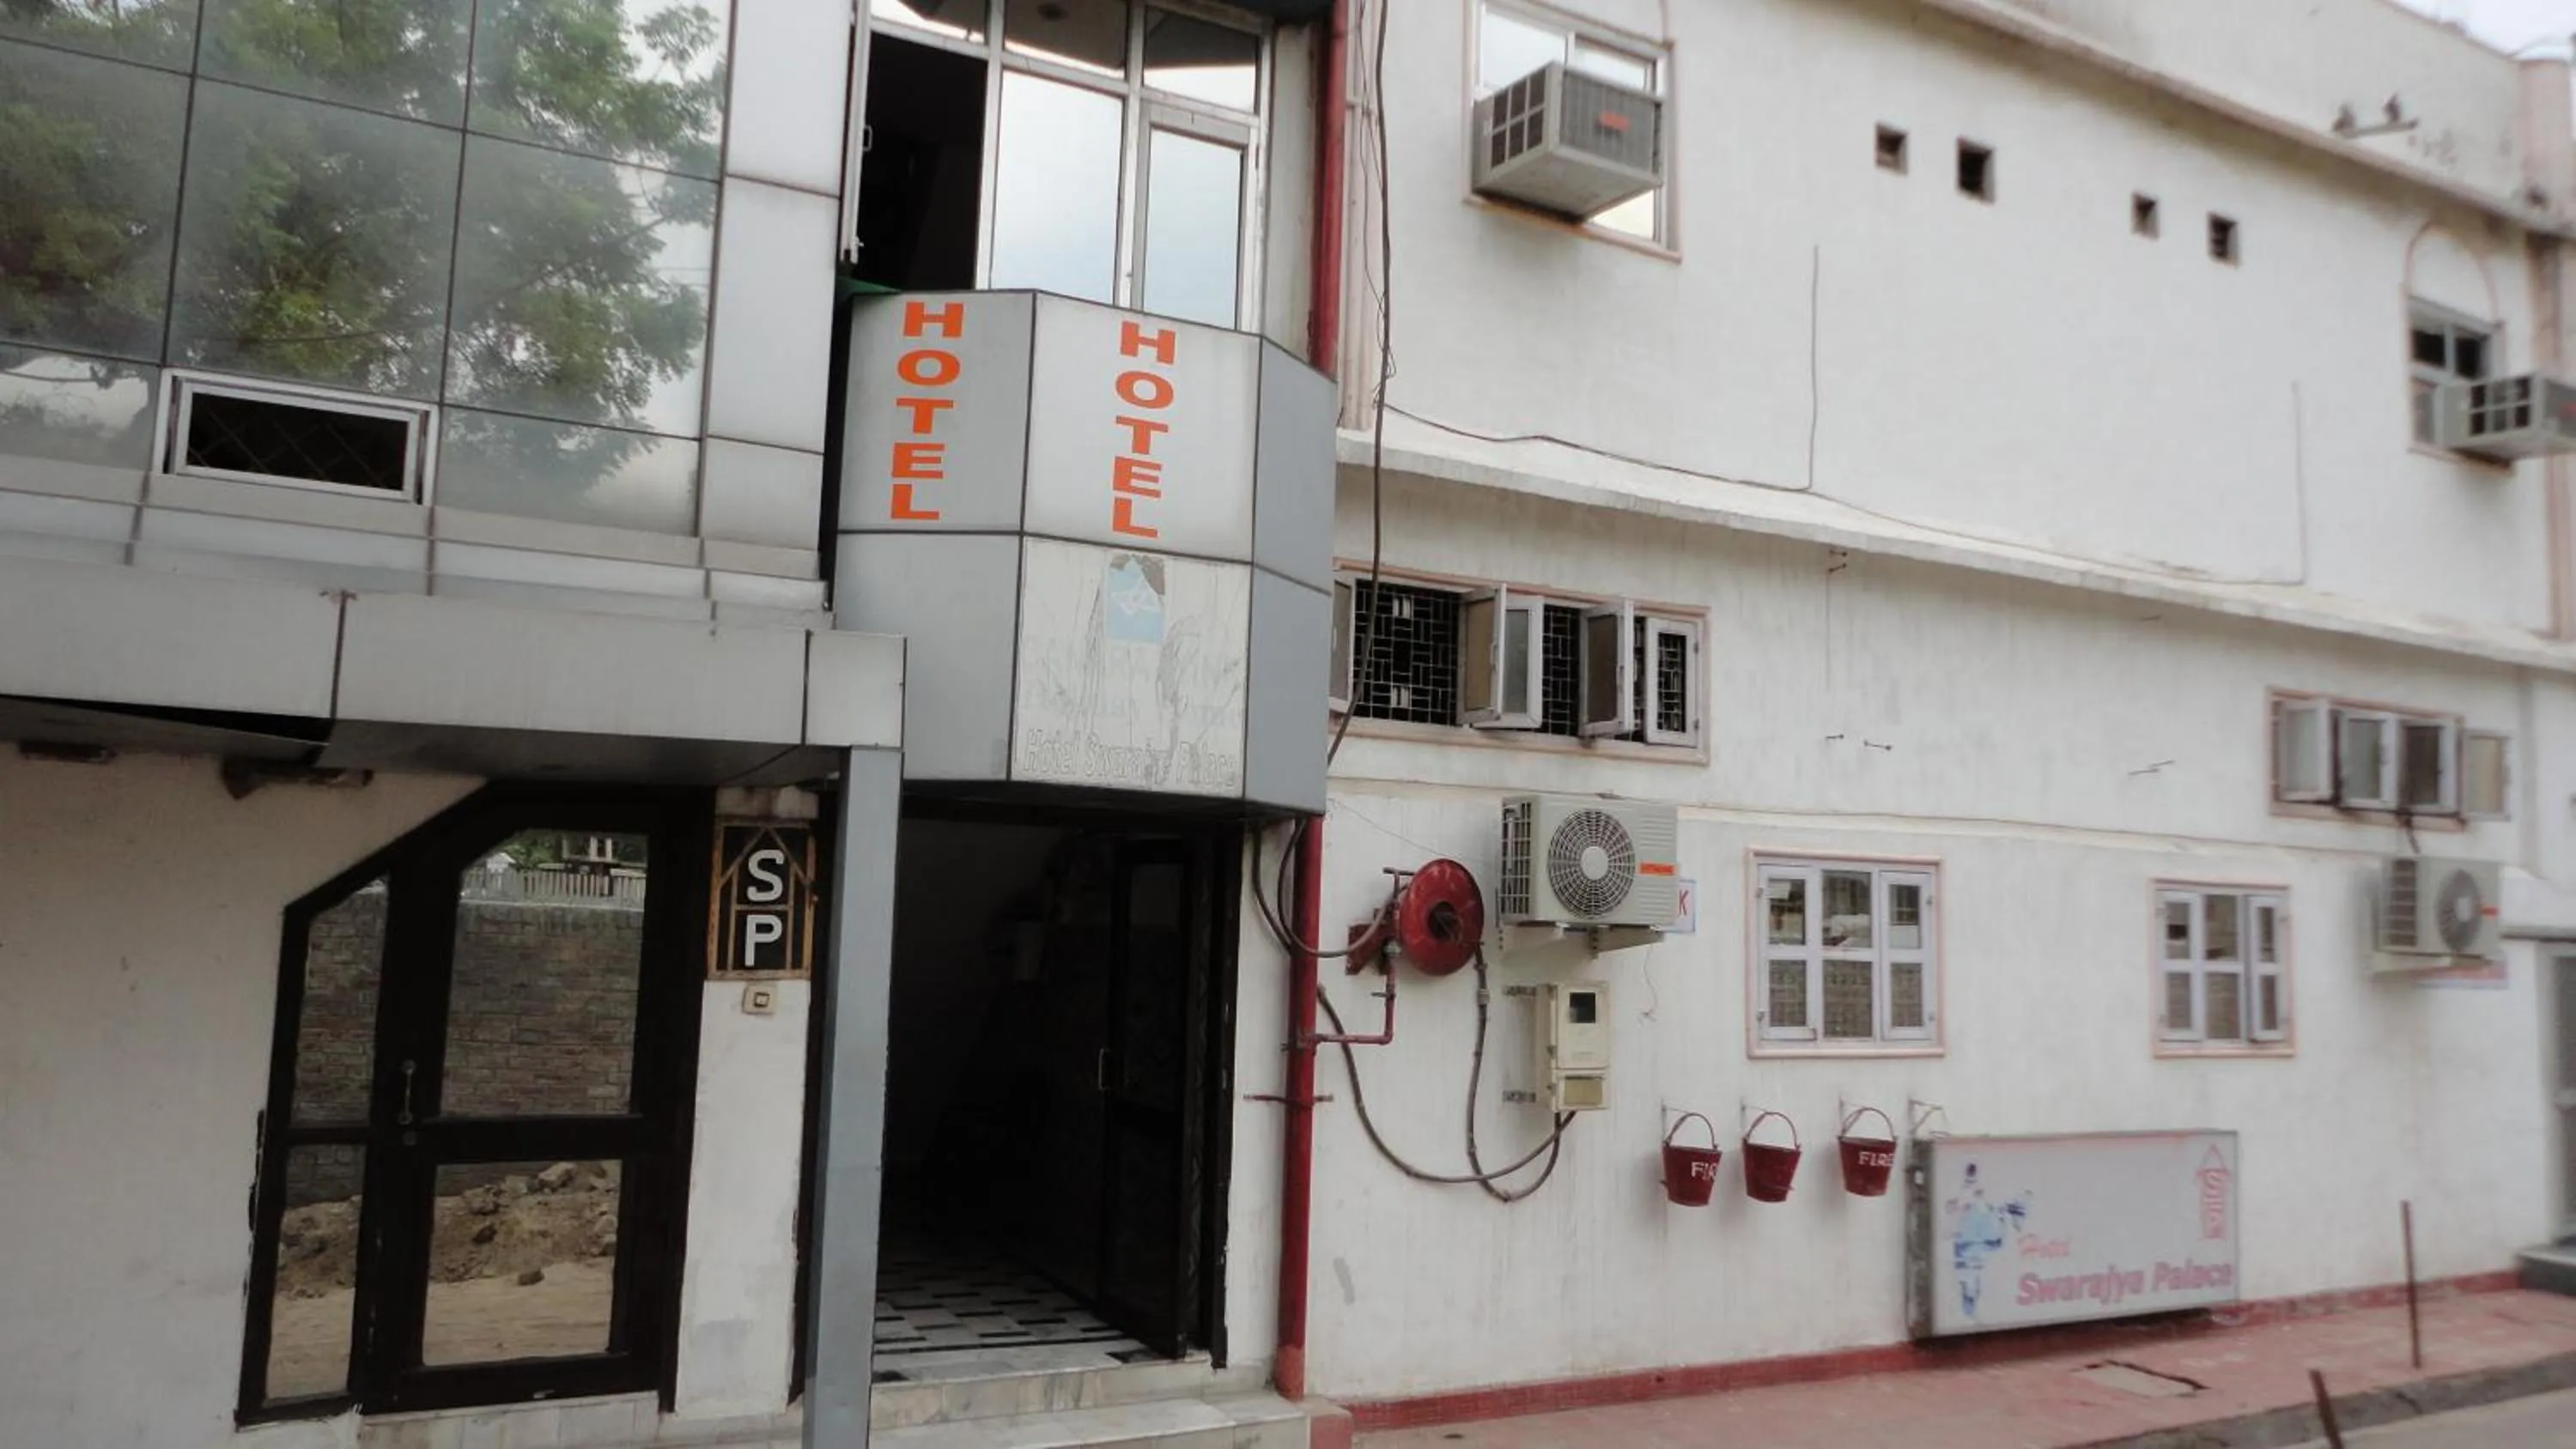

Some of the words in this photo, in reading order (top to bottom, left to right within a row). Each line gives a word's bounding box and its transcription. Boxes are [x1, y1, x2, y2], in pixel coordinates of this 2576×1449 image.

[890, 301, 964, 520] HOTEL
[1112, 320, 1176, 539] HOTEL
[1858, 1151, 1893, 1167] FIRE
[2015, 1264, 2145, 1306] Swarajya
[2151, 1258, 2233, 1293] Palace
